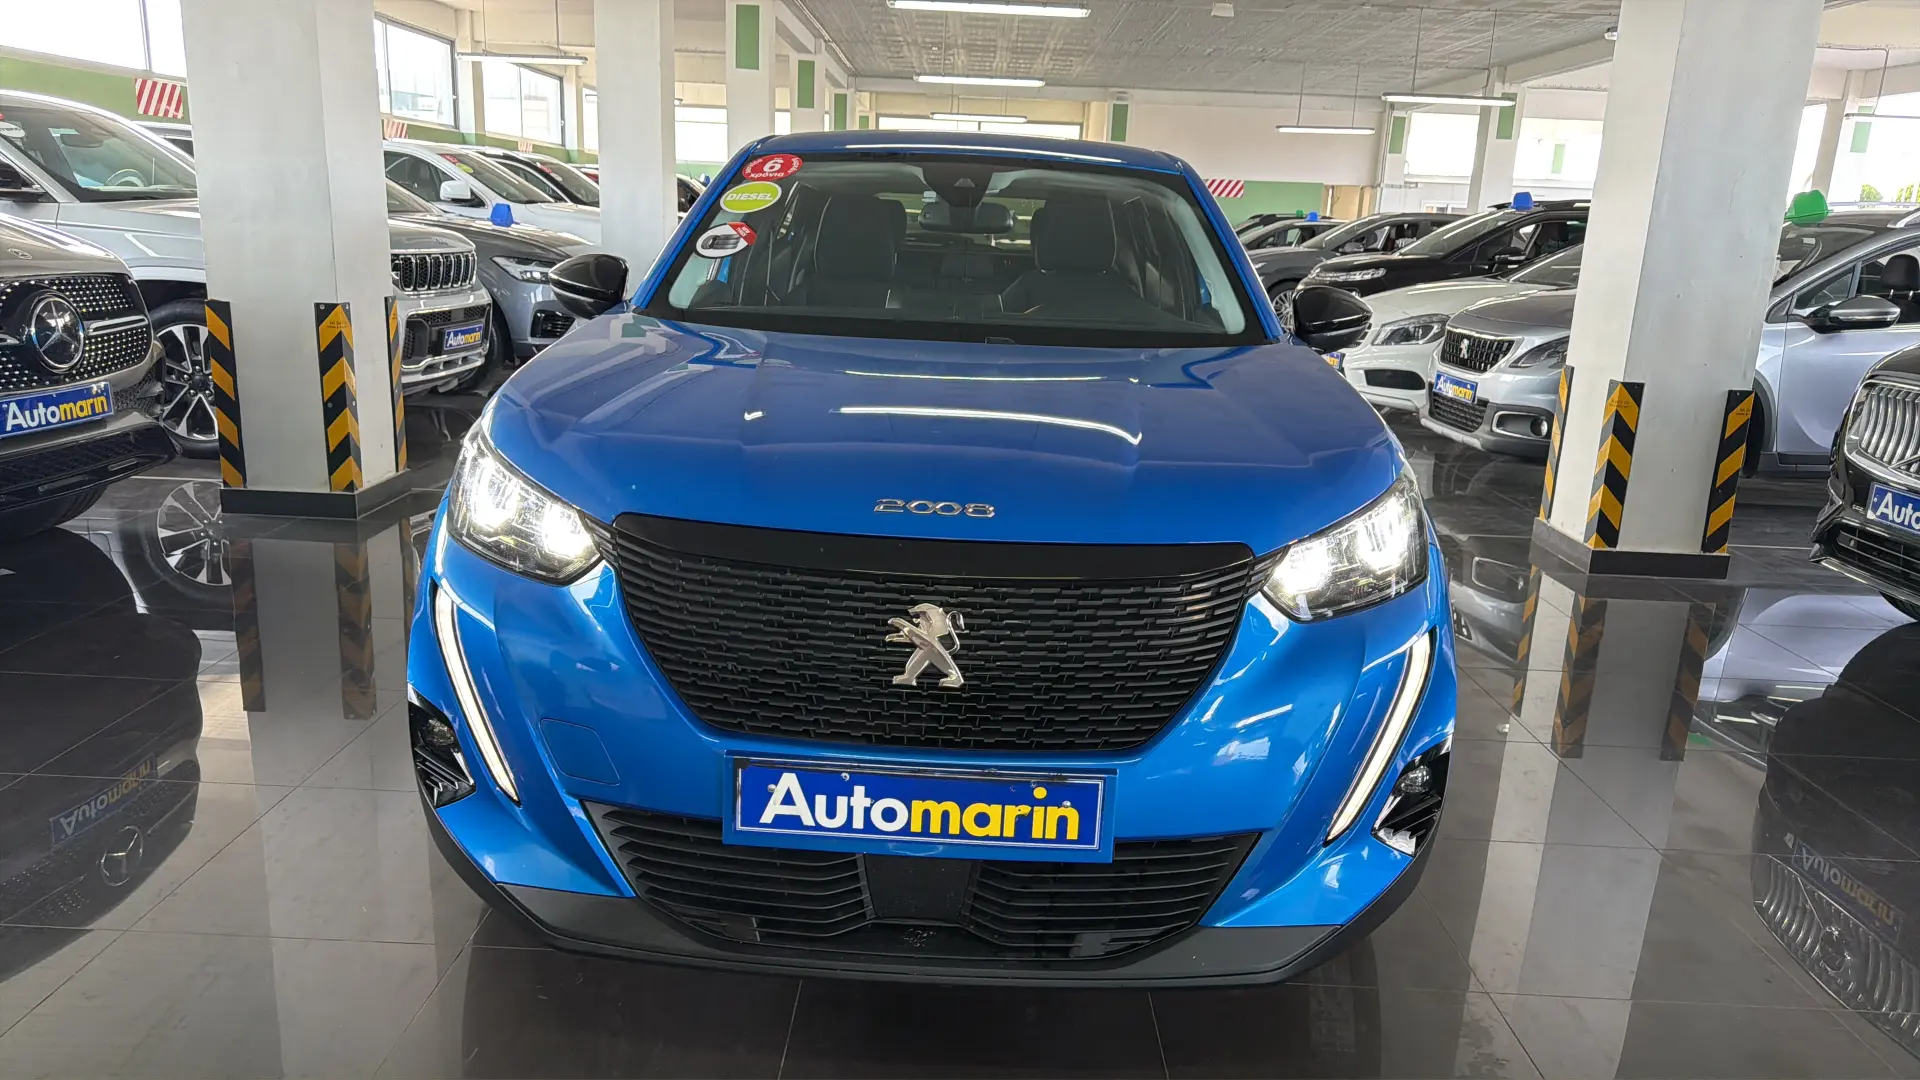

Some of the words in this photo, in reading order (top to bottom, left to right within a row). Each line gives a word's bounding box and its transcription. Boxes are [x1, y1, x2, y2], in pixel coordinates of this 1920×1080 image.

[763, 159, 784, 172] 6
[726, 193, 774, 201] DIESEL
[446, 328, 481, 347] Automarin
[6, 390, 108, 431] Automarin
[874, 499, 995, 518] 2008
[759, 772, 1079, 840] Automarin
